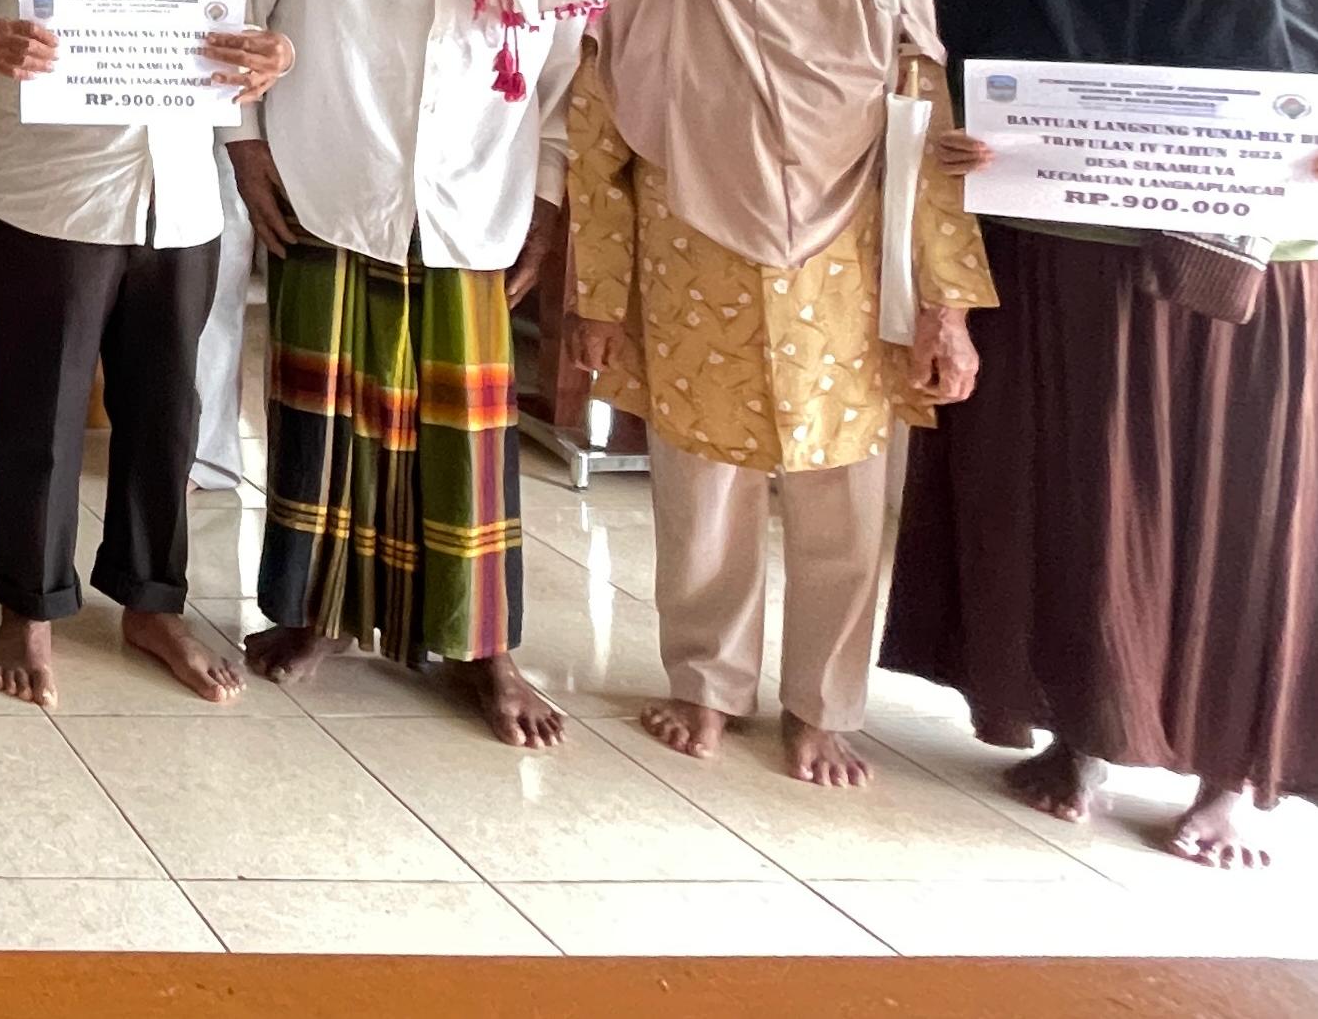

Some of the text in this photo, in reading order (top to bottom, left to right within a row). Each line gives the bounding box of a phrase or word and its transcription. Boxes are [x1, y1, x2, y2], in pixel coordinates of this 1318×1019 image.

[86, 94, 194, 106] RP.900.000
[1007, 115, 1088, 128] BANTUAN
[1094, 121, 1189, 135] LANGSUNG
[1042, 135, 1133, 151] TRIWULAN
[1140, 143, 1157, 153] IV
[1163, 144, 1227, 157] TAHUN
[1084, 157, 1127, 168] DESA
[1036, 168, 1133, 186] KECAMATAN
[1064, 190, 1250, 216] RP.900.000
